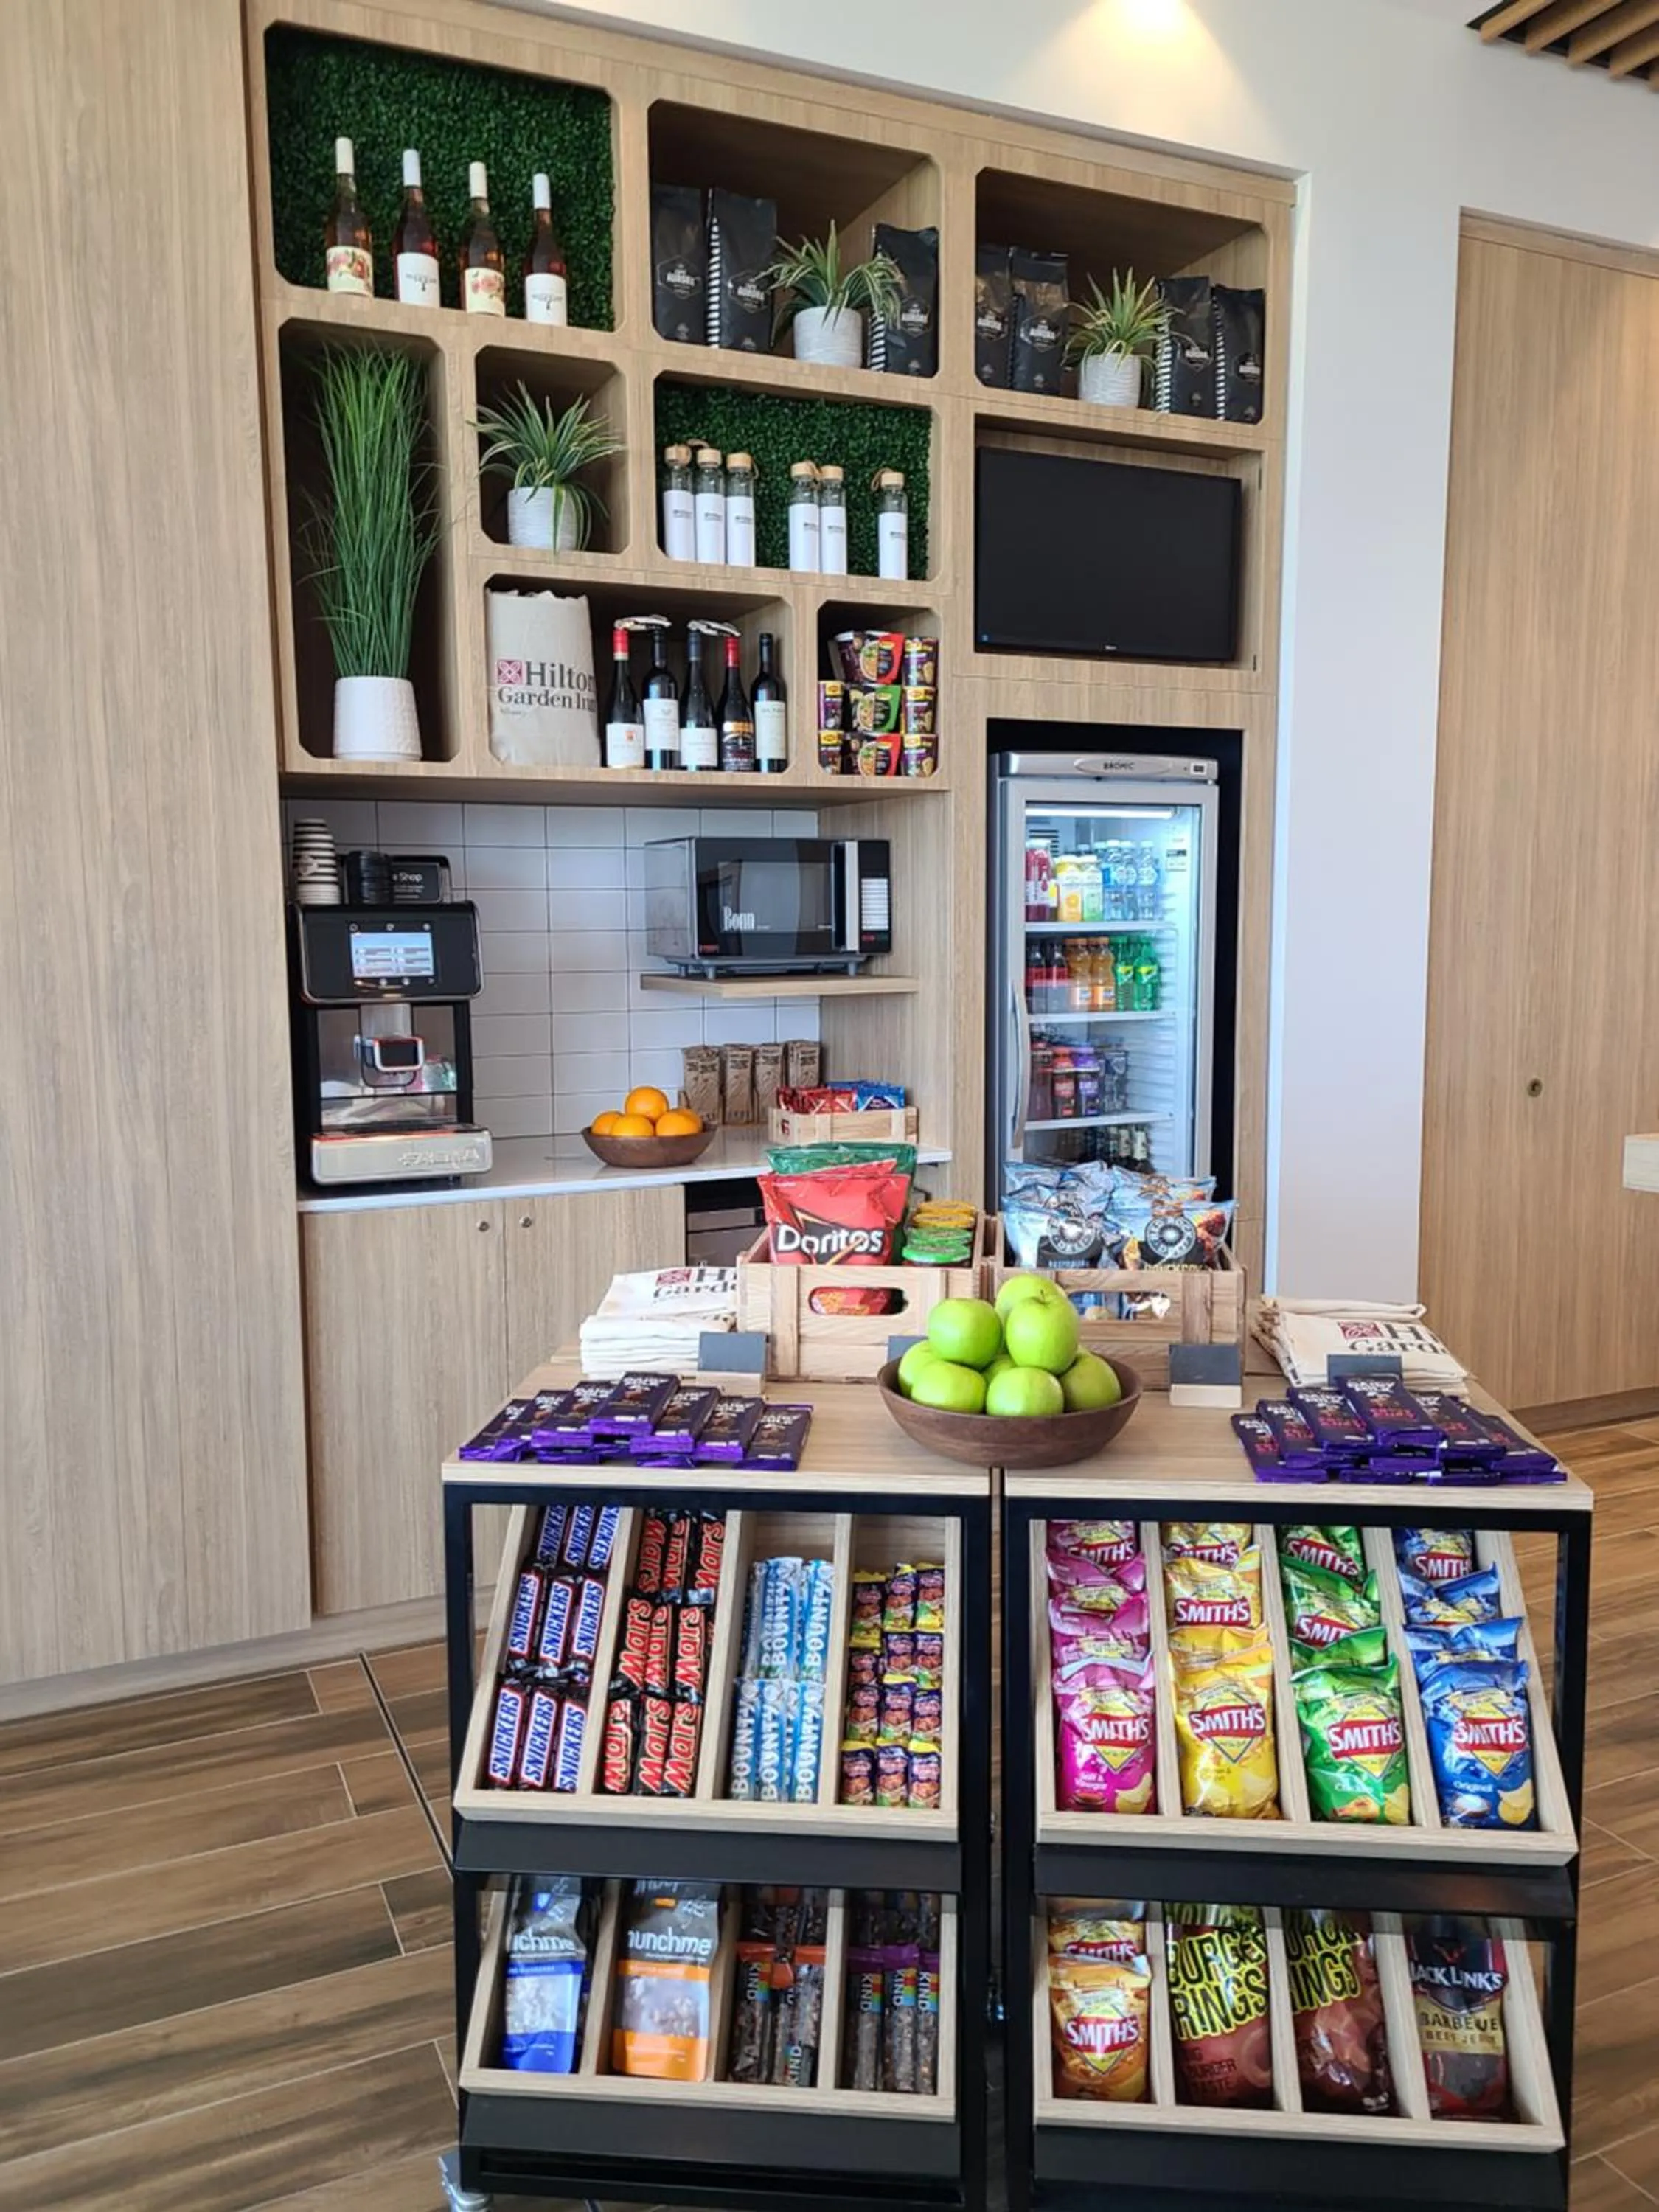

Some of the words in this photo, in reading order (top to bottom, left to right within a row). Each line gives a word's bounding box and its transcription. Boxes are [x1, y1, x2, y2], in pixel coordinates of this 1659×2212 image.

[498, 686, 572, 708] Garden
[777, 1223, 884, 1254] Doritos
[510, 1576, 535, 1651] SNICKERS
[543, 1584, 569, 1658] SNICKERS
[576, 1582, 602, 1655] SNICKERS
[804, 1580, 831, 1666] BOUNTY
[492, 1692, 519, 1778] SNICKERS
[525, 1697, 554, 1781] SNICKERS
[559, 1706, 585, 1792] SNICKERS
[639, 1697, 671, 1793] Mars
[664, 1701, 697, 1793] Mars
[760, 1704, 779, 1800] BOUNTY
[795, 1706, 821, 1801] BOUNTY
[860, 1973, 874, 2011] KIND
[918, 1972, 932, 2011] KIND
